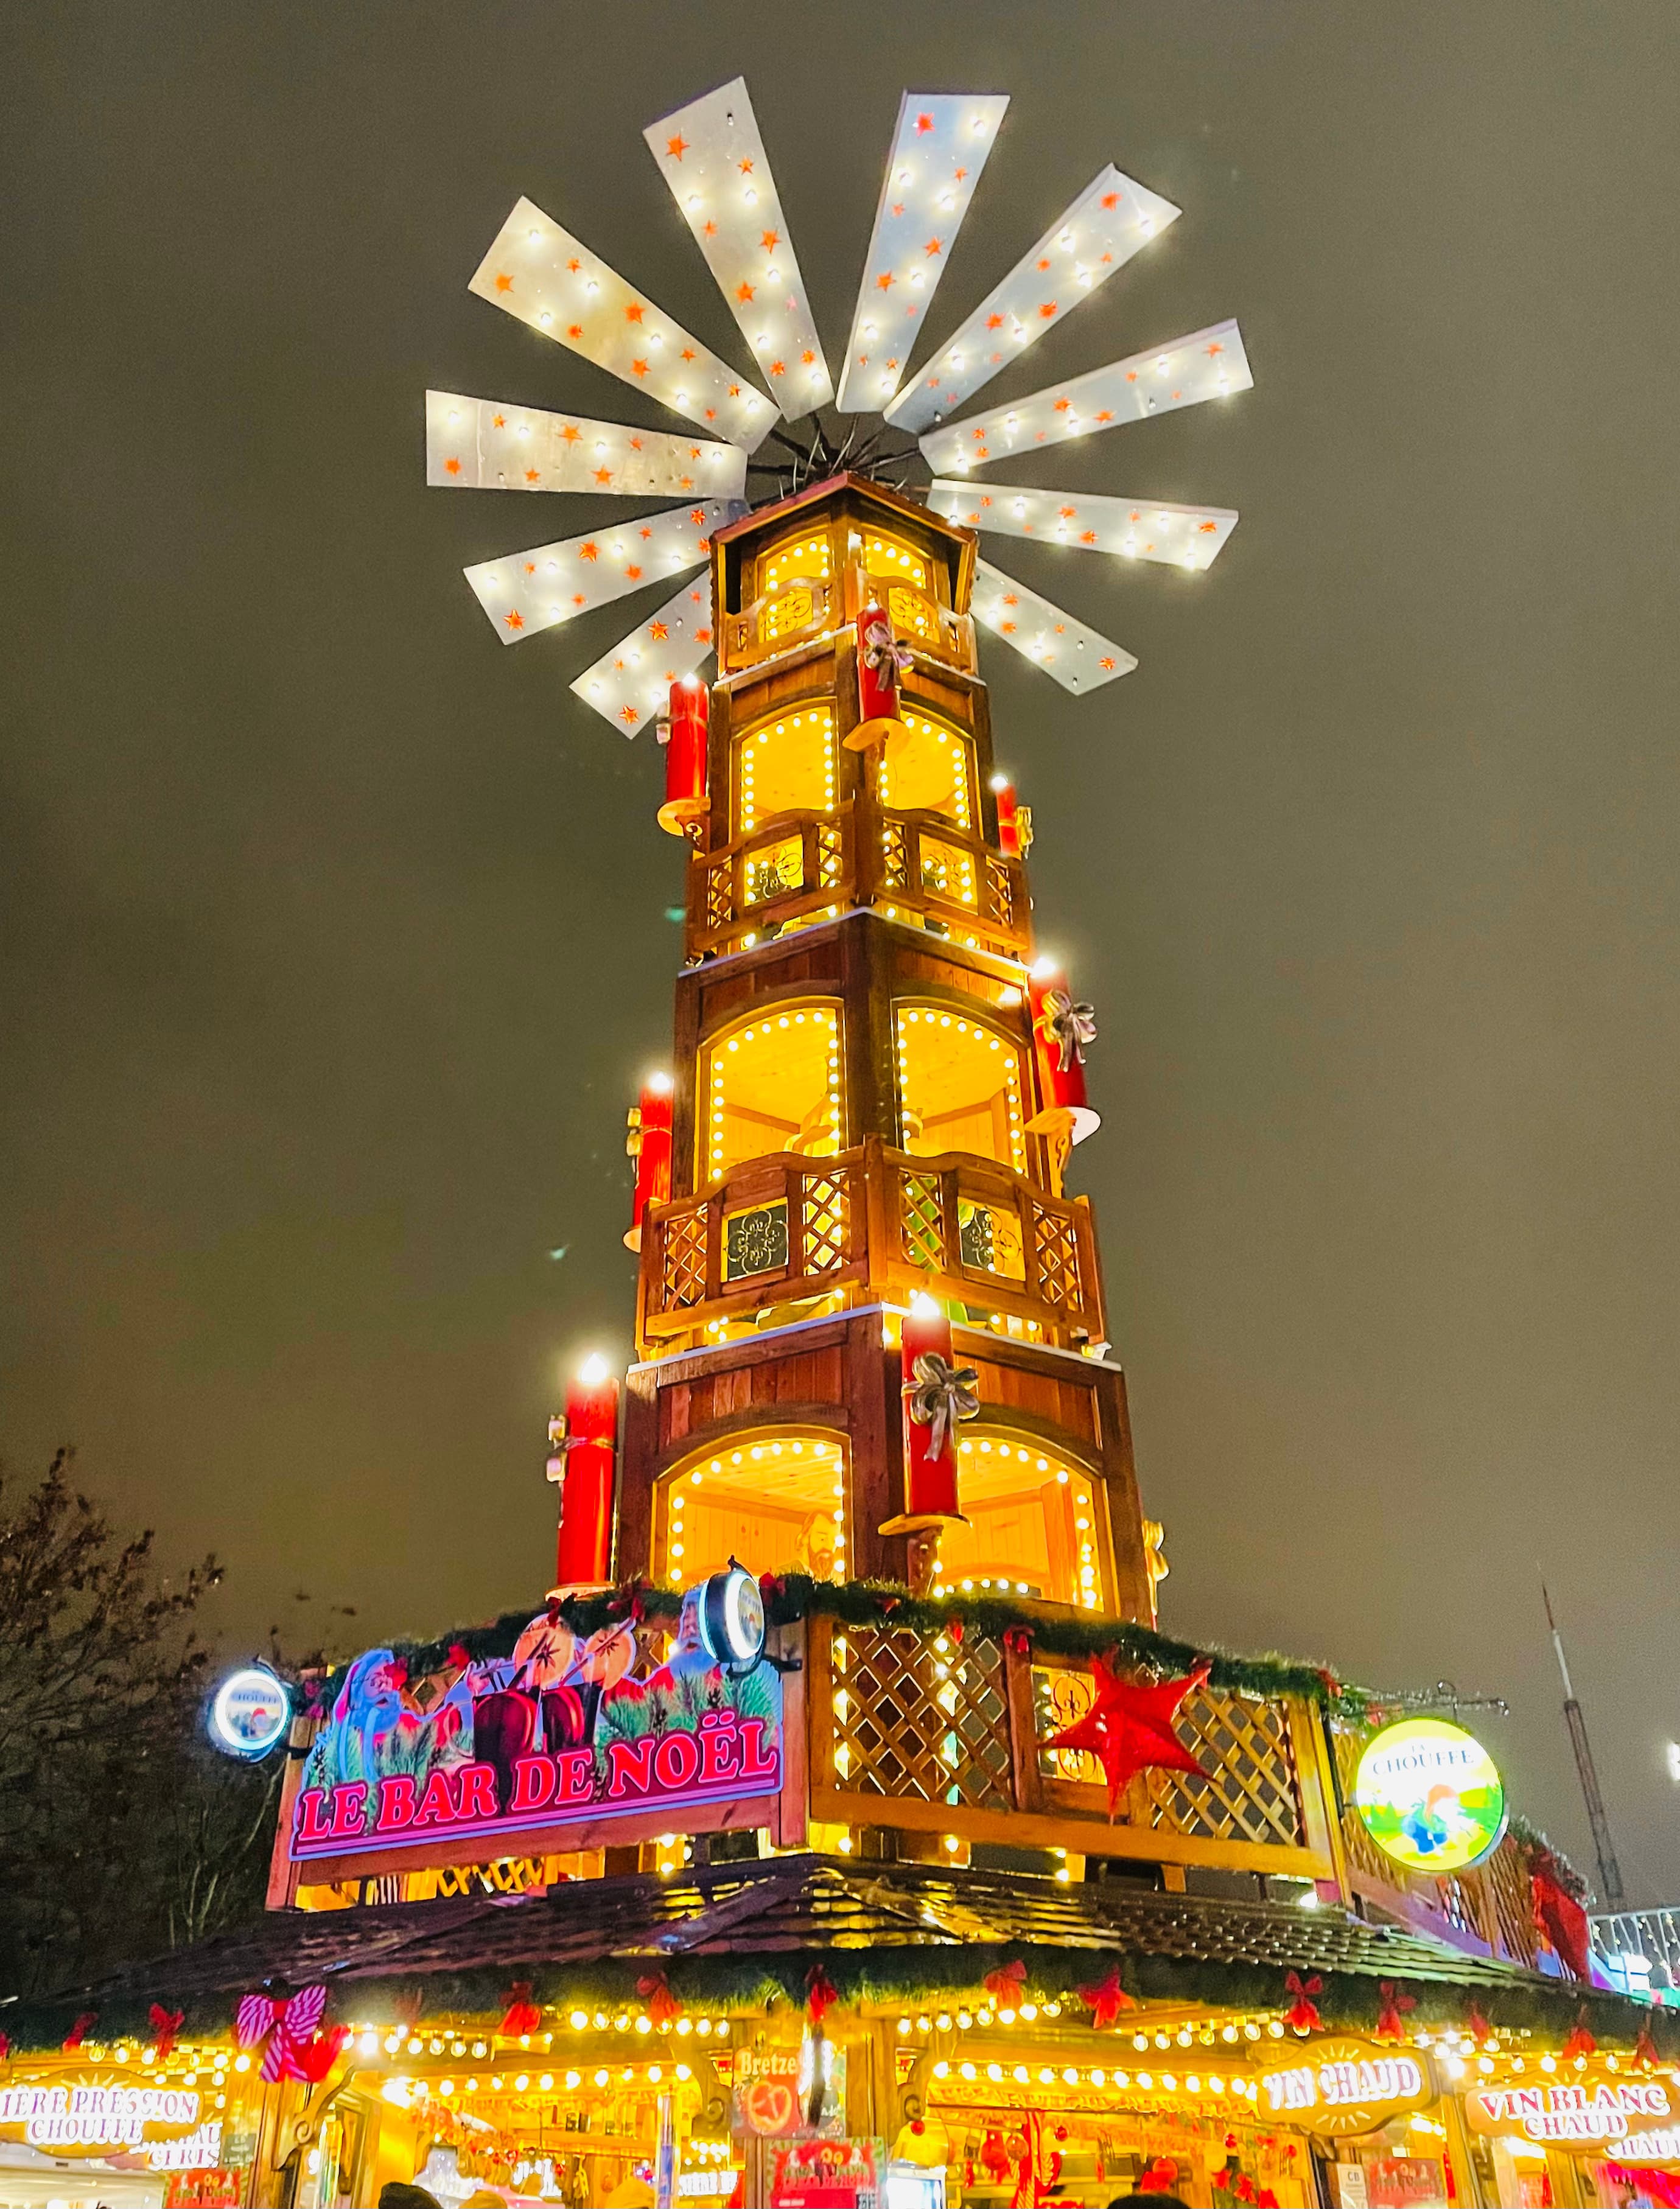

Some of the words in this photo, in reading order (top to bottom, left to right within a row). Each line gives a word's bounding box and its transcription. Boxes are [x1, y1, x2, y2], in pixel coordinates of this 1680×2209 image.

[1373, 1750, 1474, 1775] CHOUFFE
[298, 1784, 365, 1841] LE
[377, 1766, 498, 1830] BAR
[511, 1748, 593, 1811] DE
[609, 1711, 777, 1797] NOËL
[740, 2052, 799, 2075] Bretze
[1262, 2067, 1316, 2110] VIN
[1319, 2056, 1422, 2105] CHAUD
[0, 2085, 66, 2117] IÈRE
[73, 2090, 197, 2119] PRESSION
[1479, 2088, 1541, 2120] VIN
[1550, 2087, 1669, 2113] BLANC
[30, 2118, 143, 2140] CHOUFFE
[1524, 2113, 1626, 2138] CHAUD
[1347, 2171, 1360, 2182] CB
